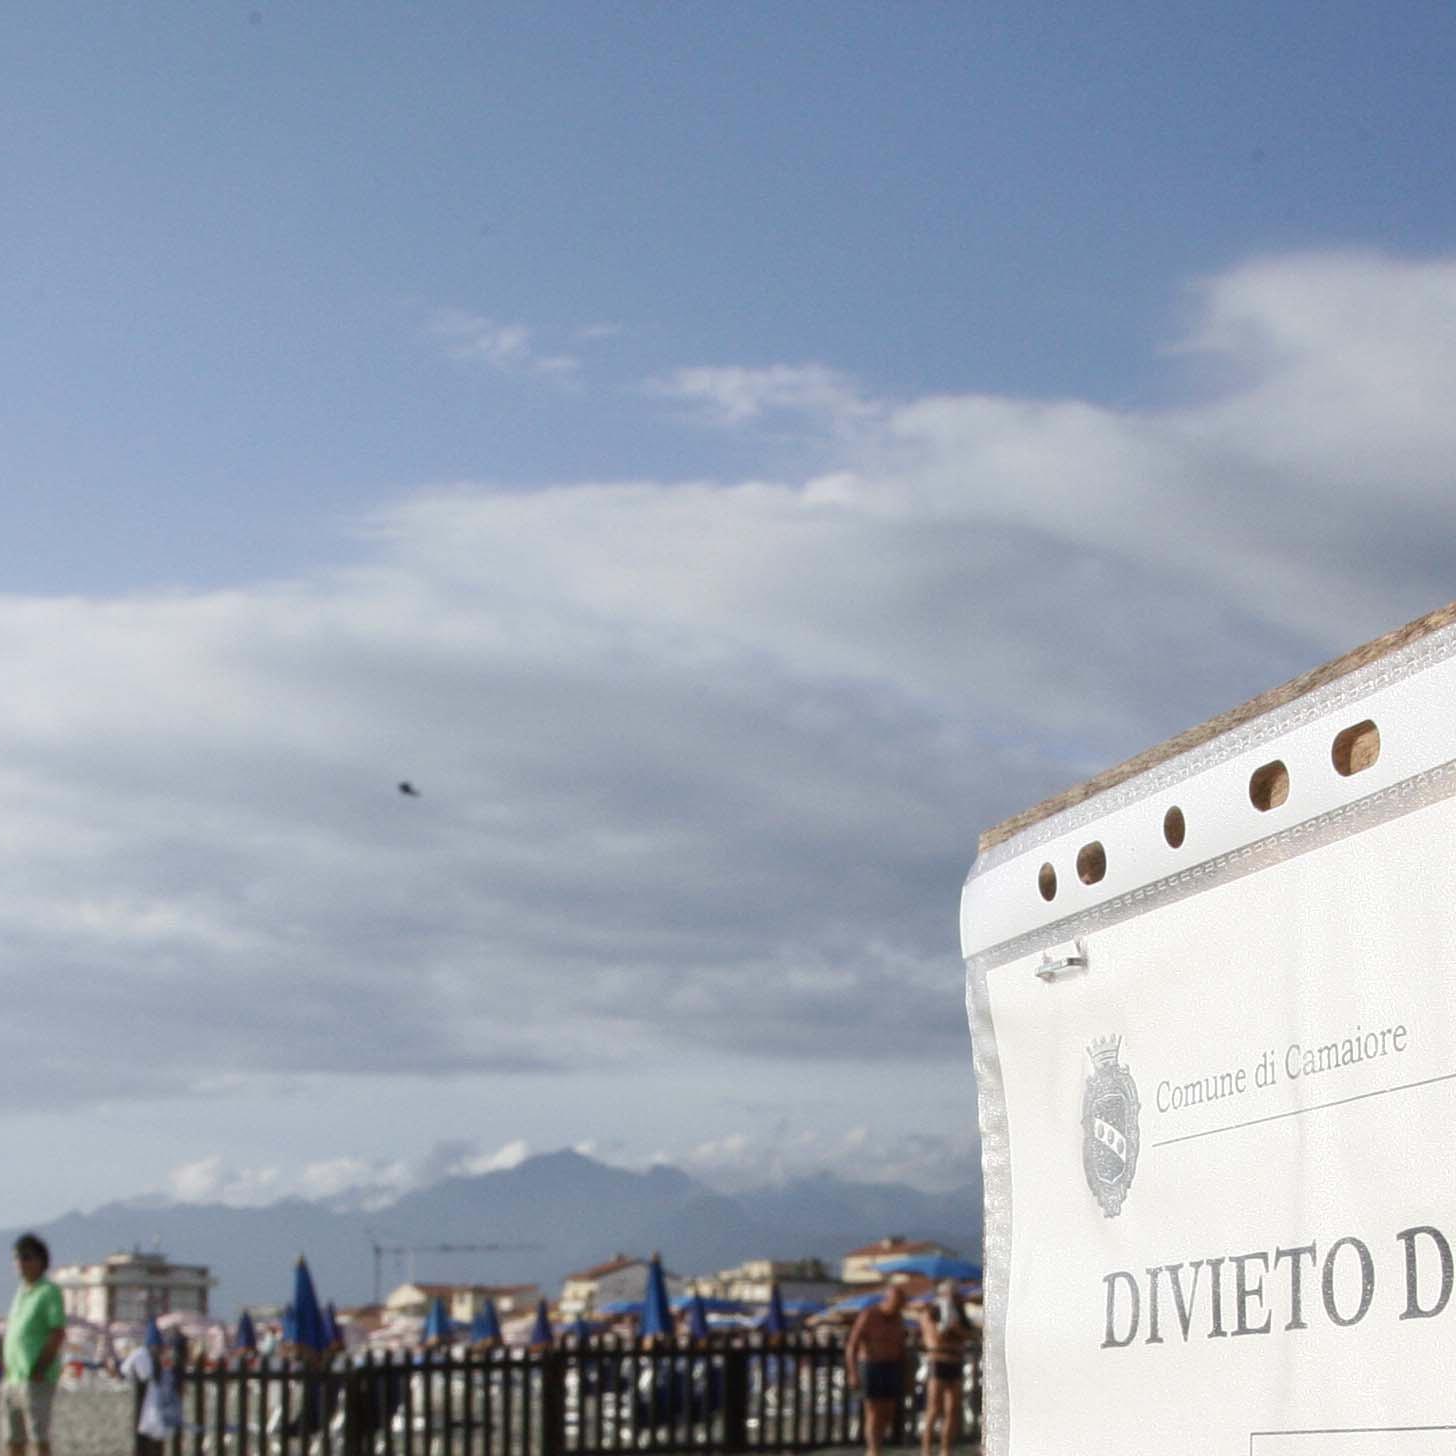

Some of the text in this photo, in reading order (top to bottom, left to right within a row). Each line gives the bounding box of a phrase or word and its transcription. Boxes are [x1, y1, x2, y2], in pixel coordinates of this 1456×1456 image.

[1154, 1023, 1409, 1115] Comune di Camaiore
[1099, 1233, 1375, 1350] DIVIETO
